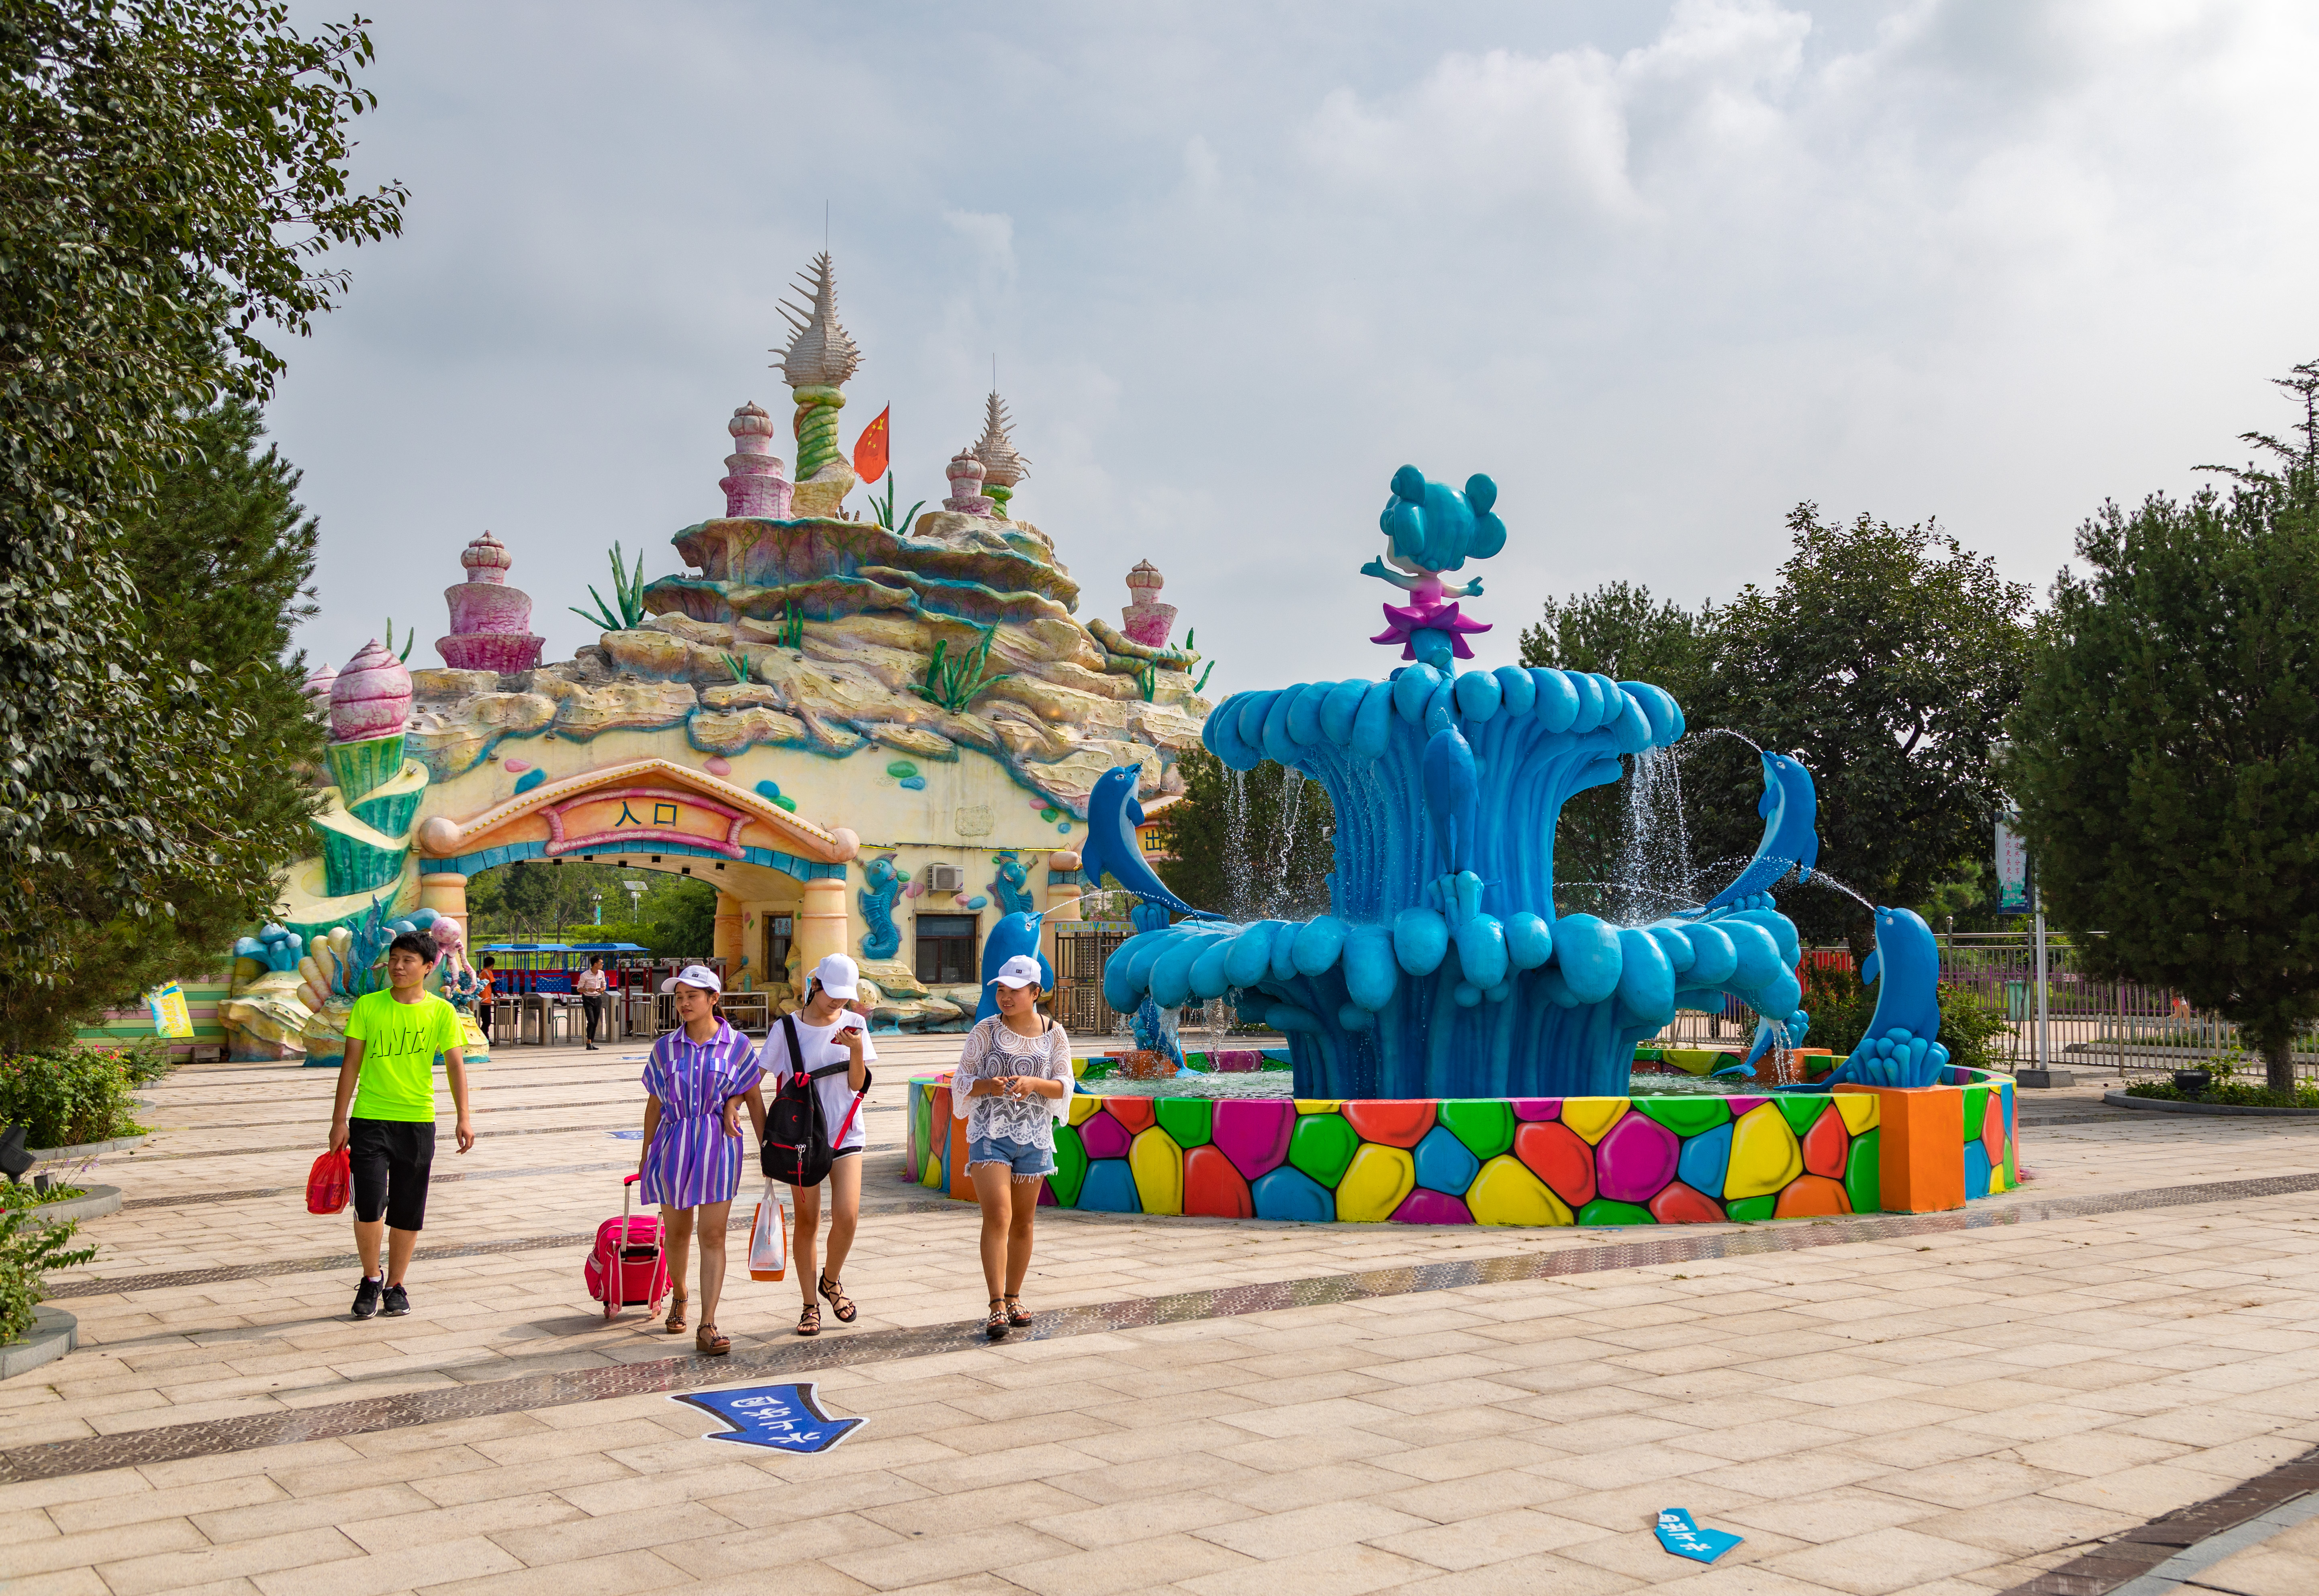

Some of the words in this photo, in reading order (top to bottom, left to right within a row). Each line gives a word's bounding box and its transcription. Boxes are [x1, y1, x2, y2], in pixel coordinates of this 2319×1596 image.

[615, 801, 677, 827] 入口
[370, 1027, 433, 1058] ANTA
[731, 1396, 821, 1443] 水上乐园
